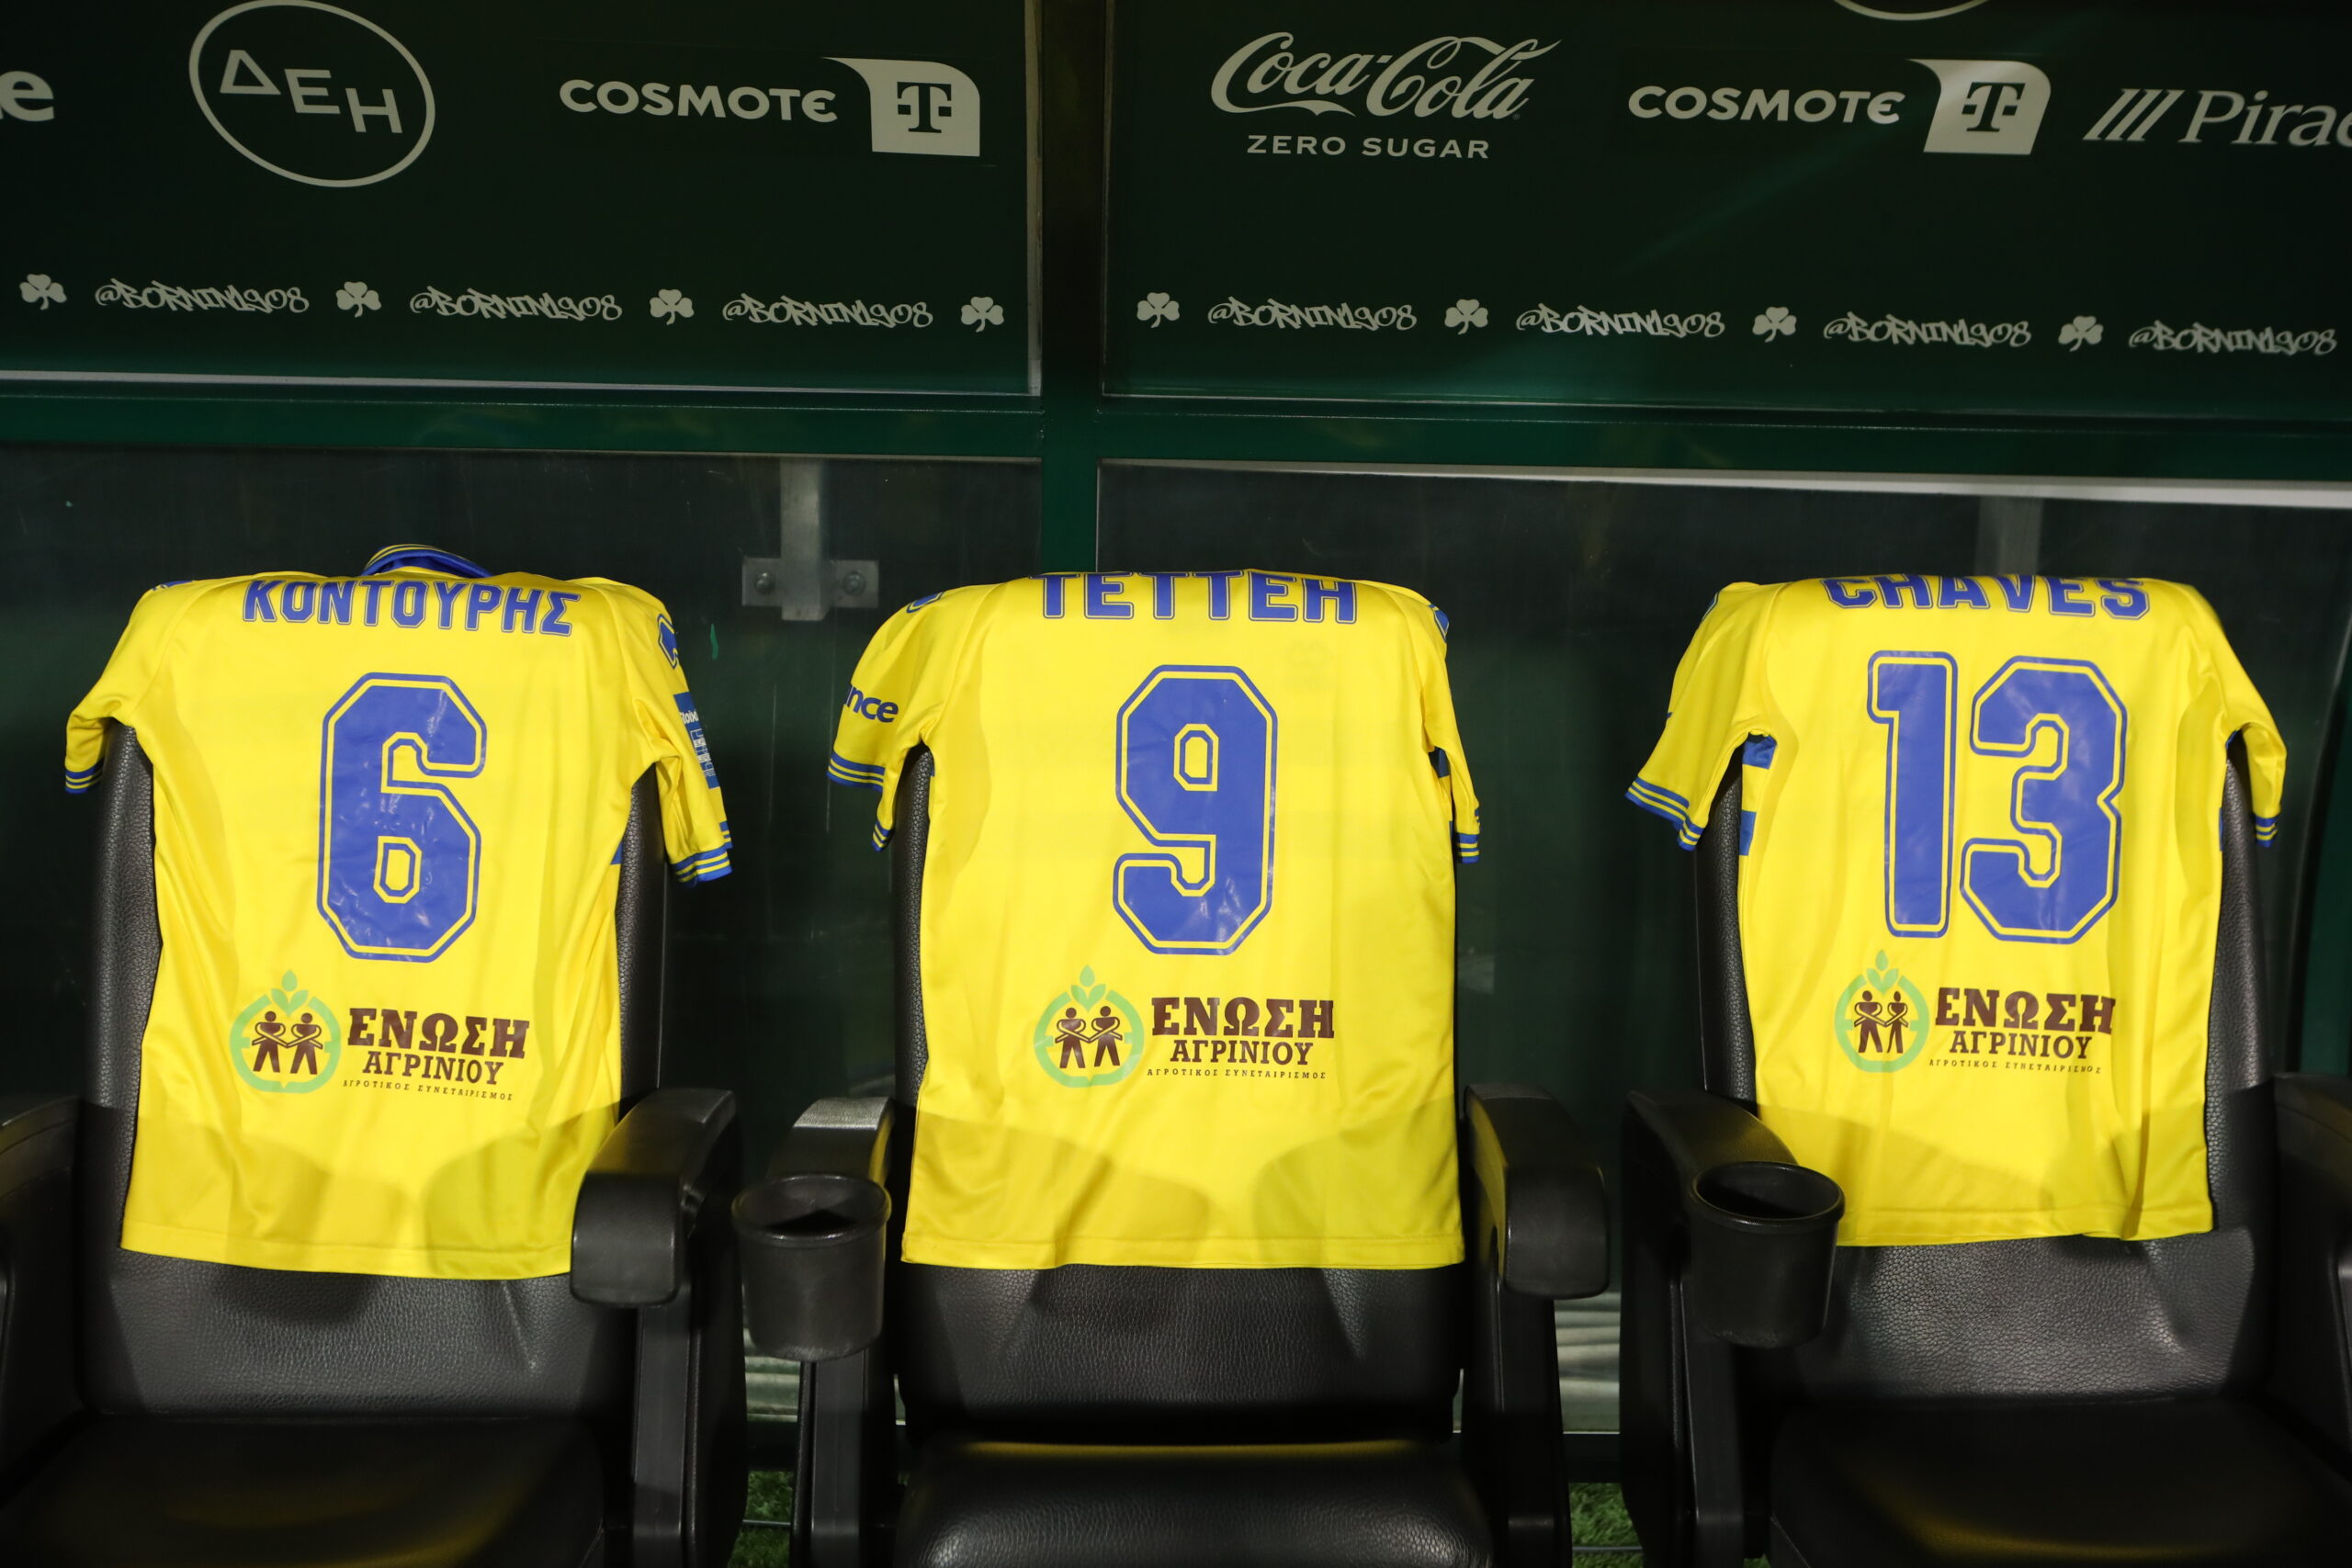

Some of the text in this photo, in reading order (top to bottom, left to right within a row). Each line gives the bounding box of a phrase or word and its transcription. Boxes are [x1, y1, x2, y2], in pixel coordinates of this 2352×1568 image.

[0, 71, 55, 122] e
[220, 49, 403, 134] ΔΕΗ
[1210, 31, 1562, 119] Coca-Cola
[559, 79, 838, 123] COSMOTE
[1628, 85, 1906, 125] COSMOTE
[1247, 134, 1489, 159] ZERO SUGAR
[243, 579, 581, 637] ΚΟΝΤΟΥΡΗΣ
[1028, 570, 1358, 625] TETTEH
[1819, 573, 2150, 621] CHAVES
[846, 684, 899, 724] nce
[317, 671, 488, 963] 6
[1112, 664, 1278, 956] 9
[1867, 650, 2128, 944] 13
[347, 1007, 531, 1059] ΕΝΩΣΗ
[1151, 996, 1336, 1039] ΕΝΩΣΗ
[1935, 987, 2117, 1035] ΕΝΩΣΗ
[362, 1050, 504, 1086] ΑΓΡΙΝΙΟΥ
[1170, 1039, 1314, 1066] ΑΓΡΙΝΙΟΥ
[1949, 1031, 2093, 1059] ΑΓΡΙΝΙΟΥ
